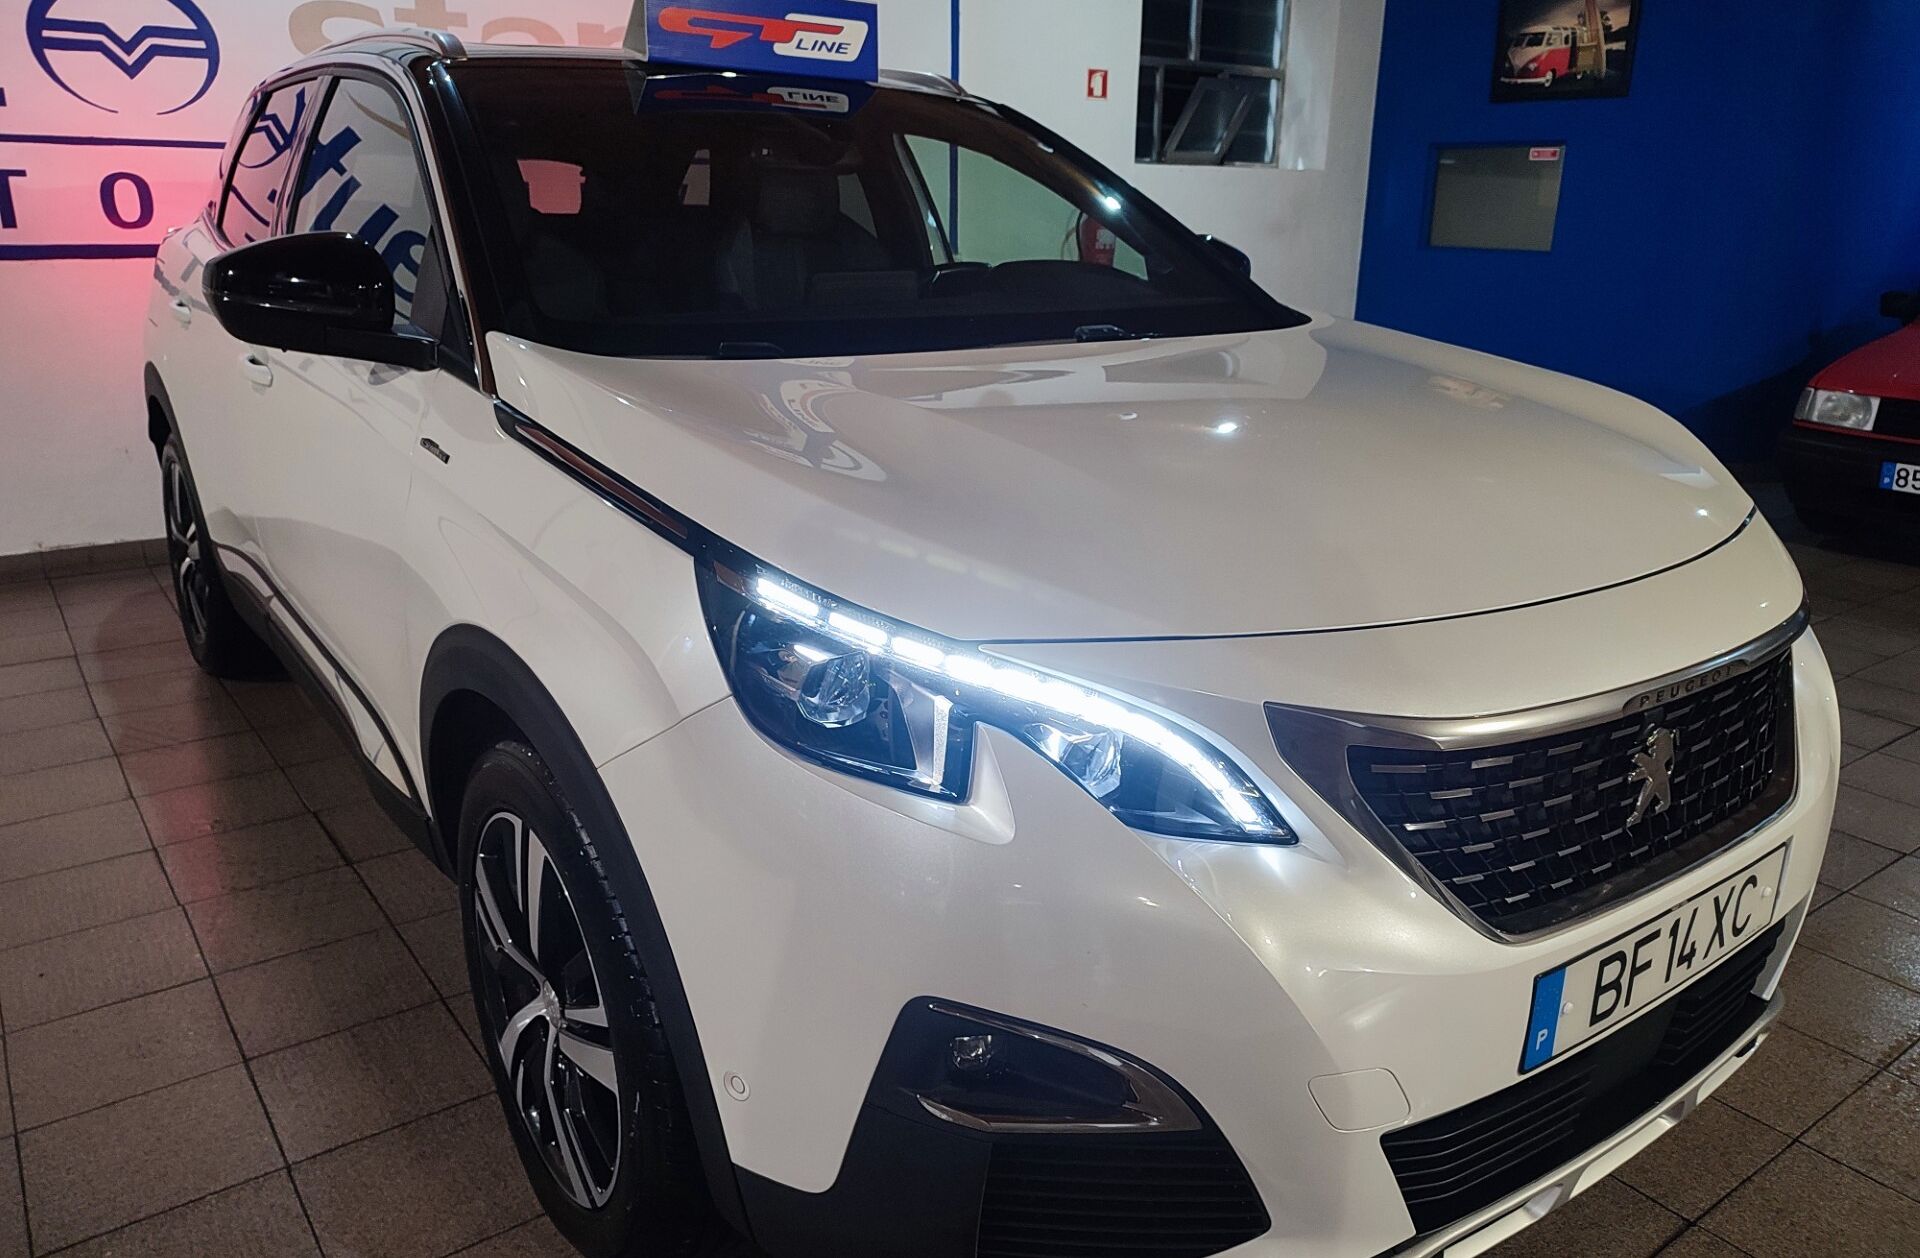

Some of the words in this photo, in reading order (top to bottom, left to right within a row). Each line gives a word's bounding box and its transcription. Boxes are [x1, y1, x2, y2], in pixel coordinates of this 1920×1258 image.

[795, 37, 852, 55] LINE
[1640, 665, 1733, 708] PEUGEOT
[1589, 927, 1662, 1027] BF
[1665, 906, 1699, 984] 14
[1703, 874, 1758, 960] XC
[1536, 1028, 1548, 1050] P
